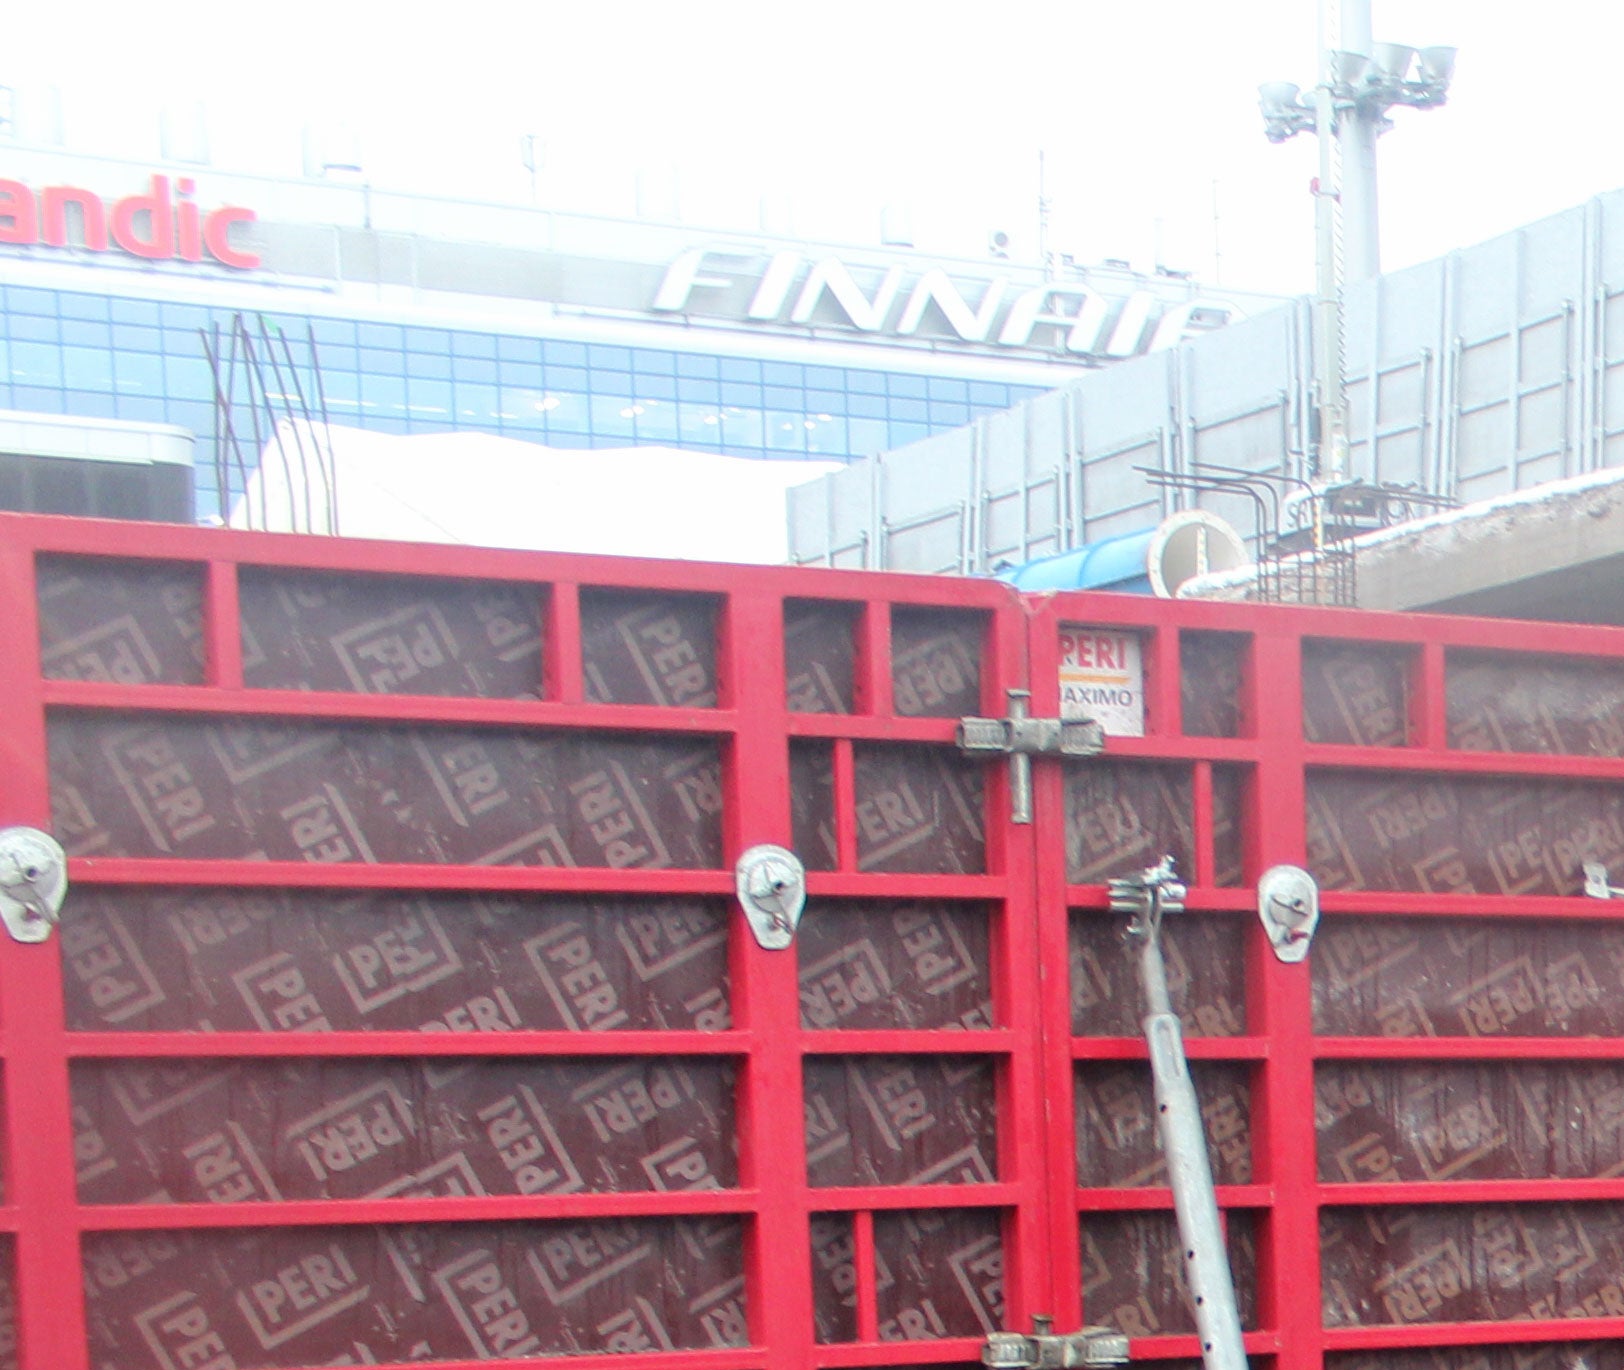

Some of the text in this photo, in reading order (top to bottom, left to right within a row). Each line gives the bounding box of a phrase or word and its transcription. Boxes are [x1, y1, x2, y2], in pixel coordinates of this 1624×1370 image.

[1062, 688, 1132, 707] AXIMO
[127, 736, 215, 841] PERI
[443, 743, 511, 815] ERI
[858, 780, 926, 842] ERI
[281, 794, 350, 862] ERI
[569, 771, 649, 867] PERI
[551, 934, 628, 1029] PERI
[799, 962, 883, 1030] PER
[1462, 990, 1538, 1037] PERI
[582, 1069, 682, 1142] PERI
[879, 1066, 936, 1138] ERI
[184, 1131, 255, 1201] ERI
[300, 1102, 401, 1181] PERI
[478, 1096, 560, 1195] PERI
[252, 1243, 359, 1323] PERI
[1385, 1264, 1462, 1323] PERI
